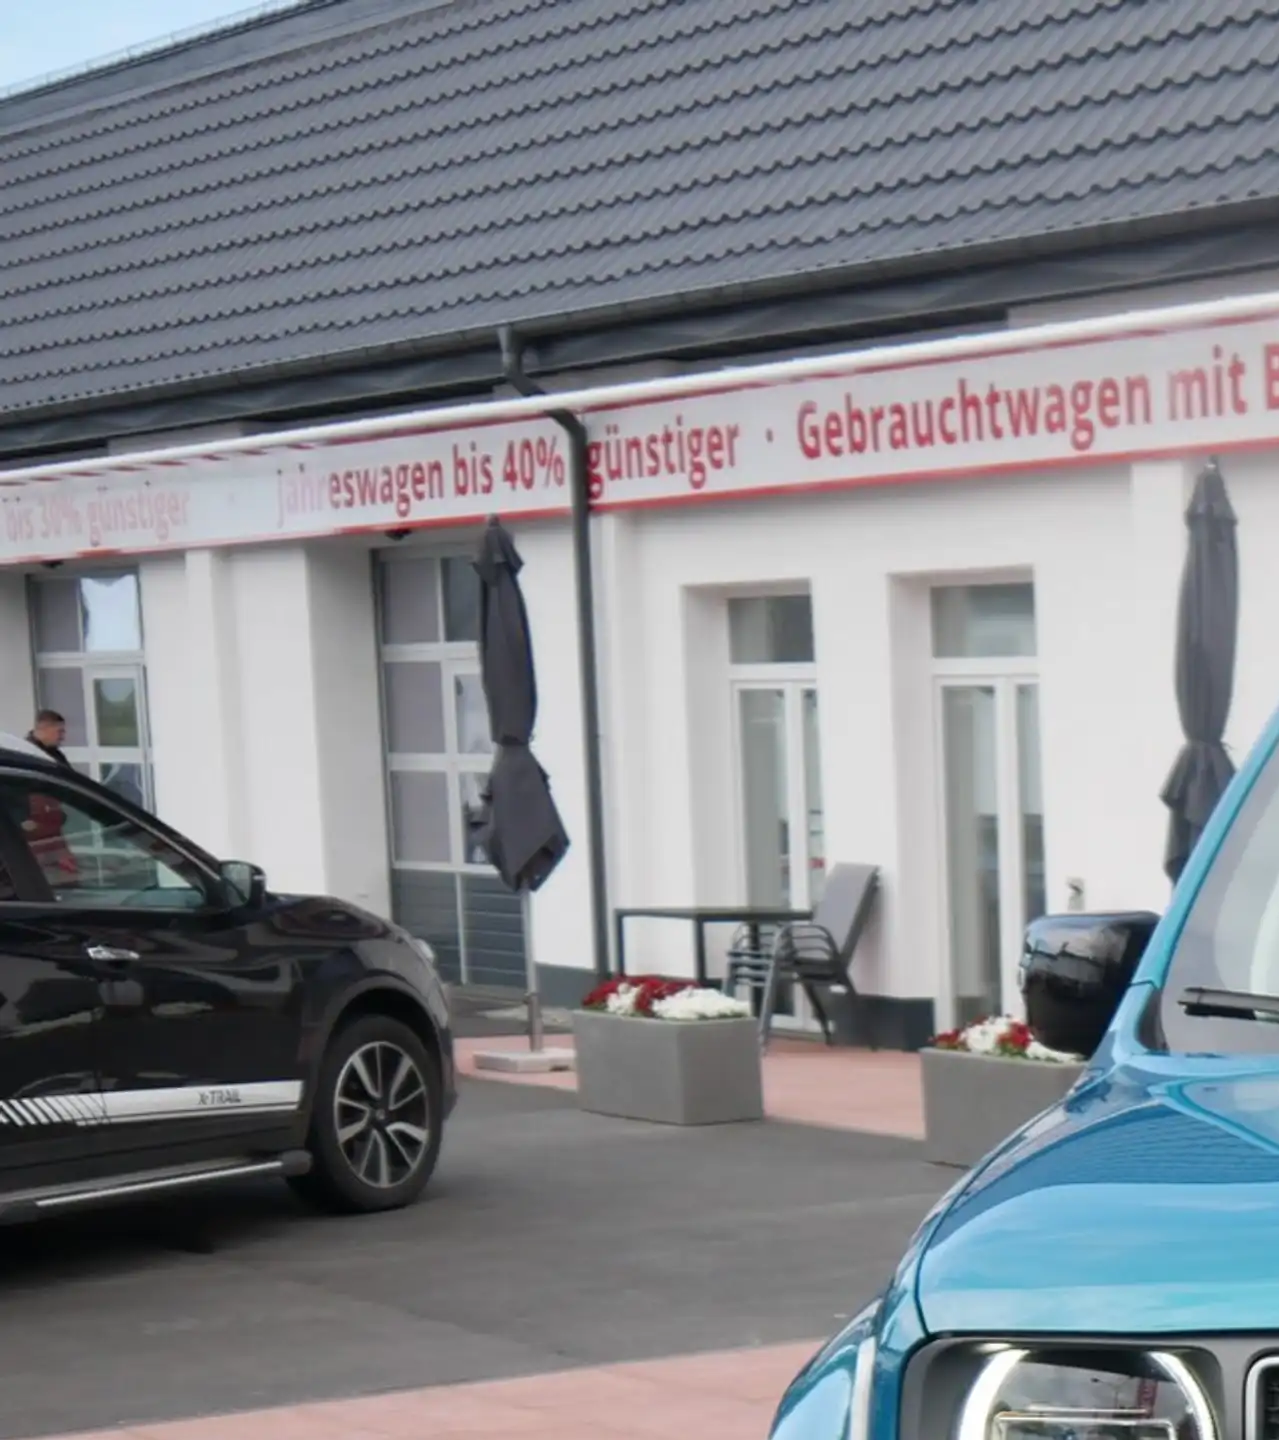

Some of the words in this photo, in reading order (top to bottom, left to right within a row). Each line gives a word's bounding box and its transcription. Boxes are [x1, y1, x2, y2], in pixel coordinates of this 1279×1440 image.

[452, 443, 494, 497] bis
[502, 438, 565, 491] 40%
[587, 412, 741, 501] günstiger
[796, 376, 1152, 460] Gebrauchtwagen
[1167, 342, 1247, 422] mit
